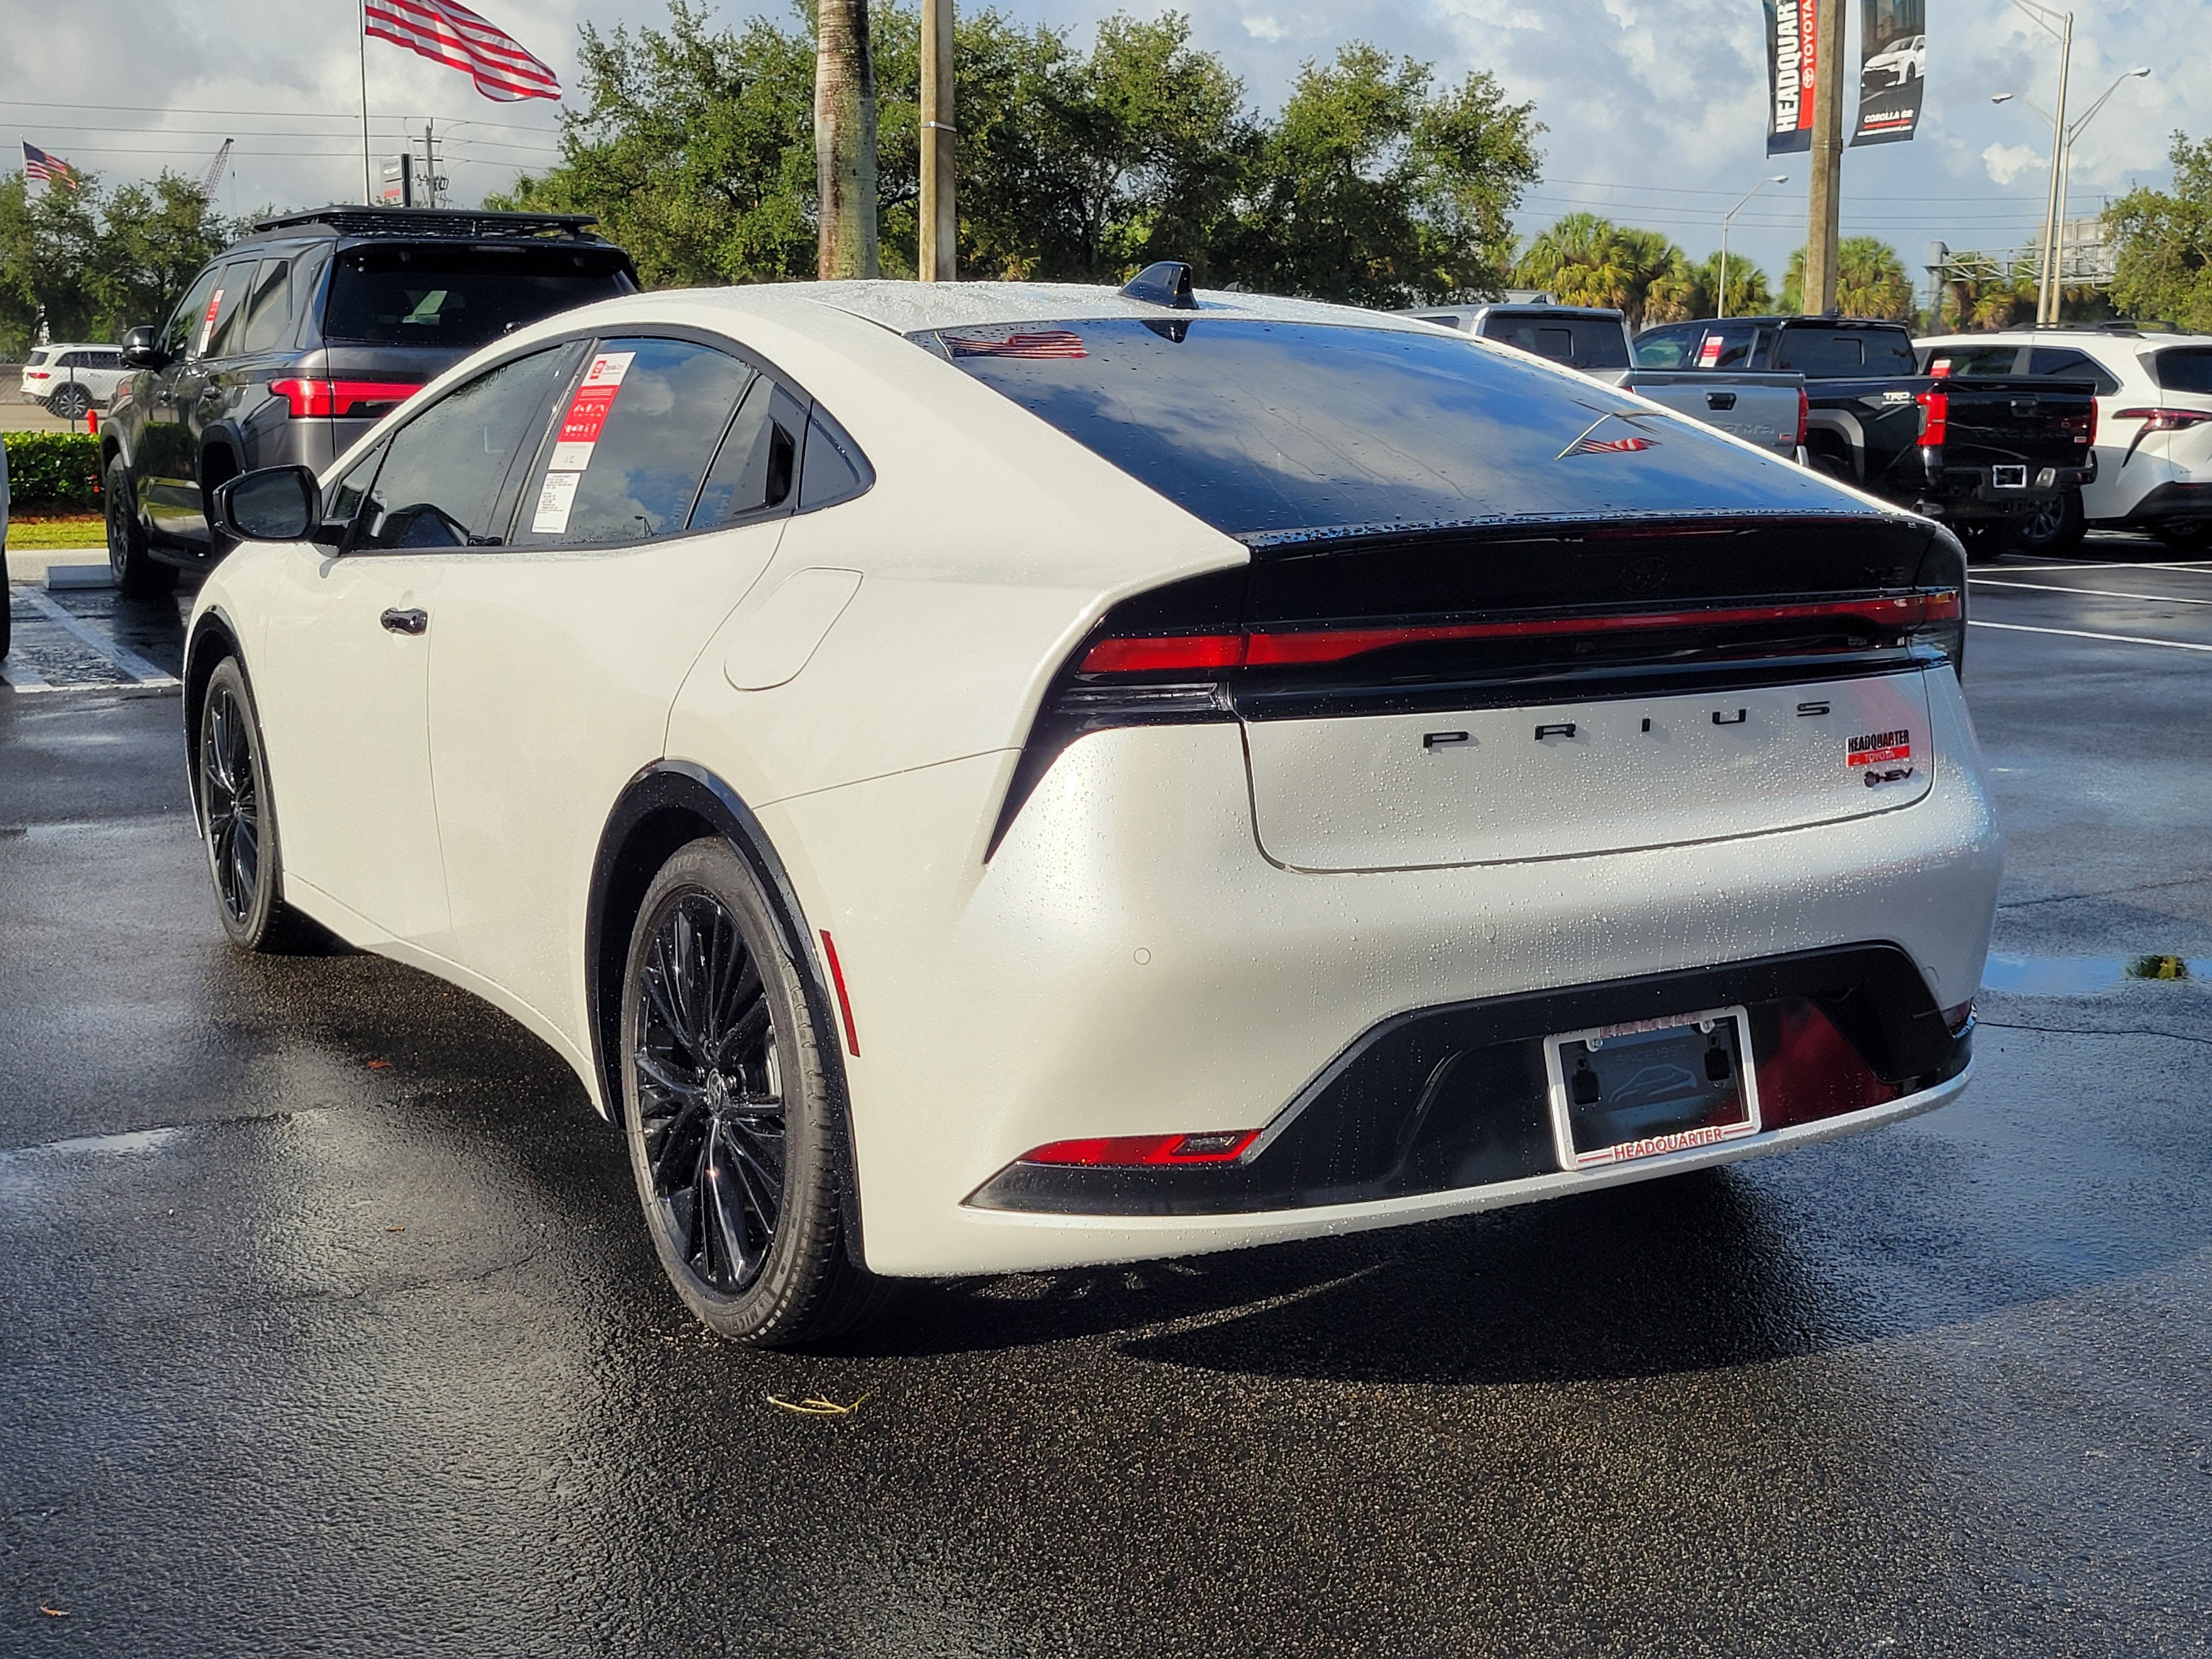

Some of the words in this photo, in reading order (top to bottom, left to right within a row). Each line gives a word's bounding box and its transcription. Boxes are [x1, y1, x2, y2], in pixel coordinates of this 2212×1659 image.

[1803, 0, 1814, 66] TOYOTA
[1864, 111, 1900, 123] COROLLA
[1882, 392, 1911, 401] TRD
[1423, 701, 1830, 748] PRIUS
[1848, 729, 1910, 753] HEADQUARTER
[1865, 749, 1895, 764] TOYOTA
[1616, 1049, 1652, 1065] SINCE
[1613, 1128, 1722, 1161] HEADQUARTER
